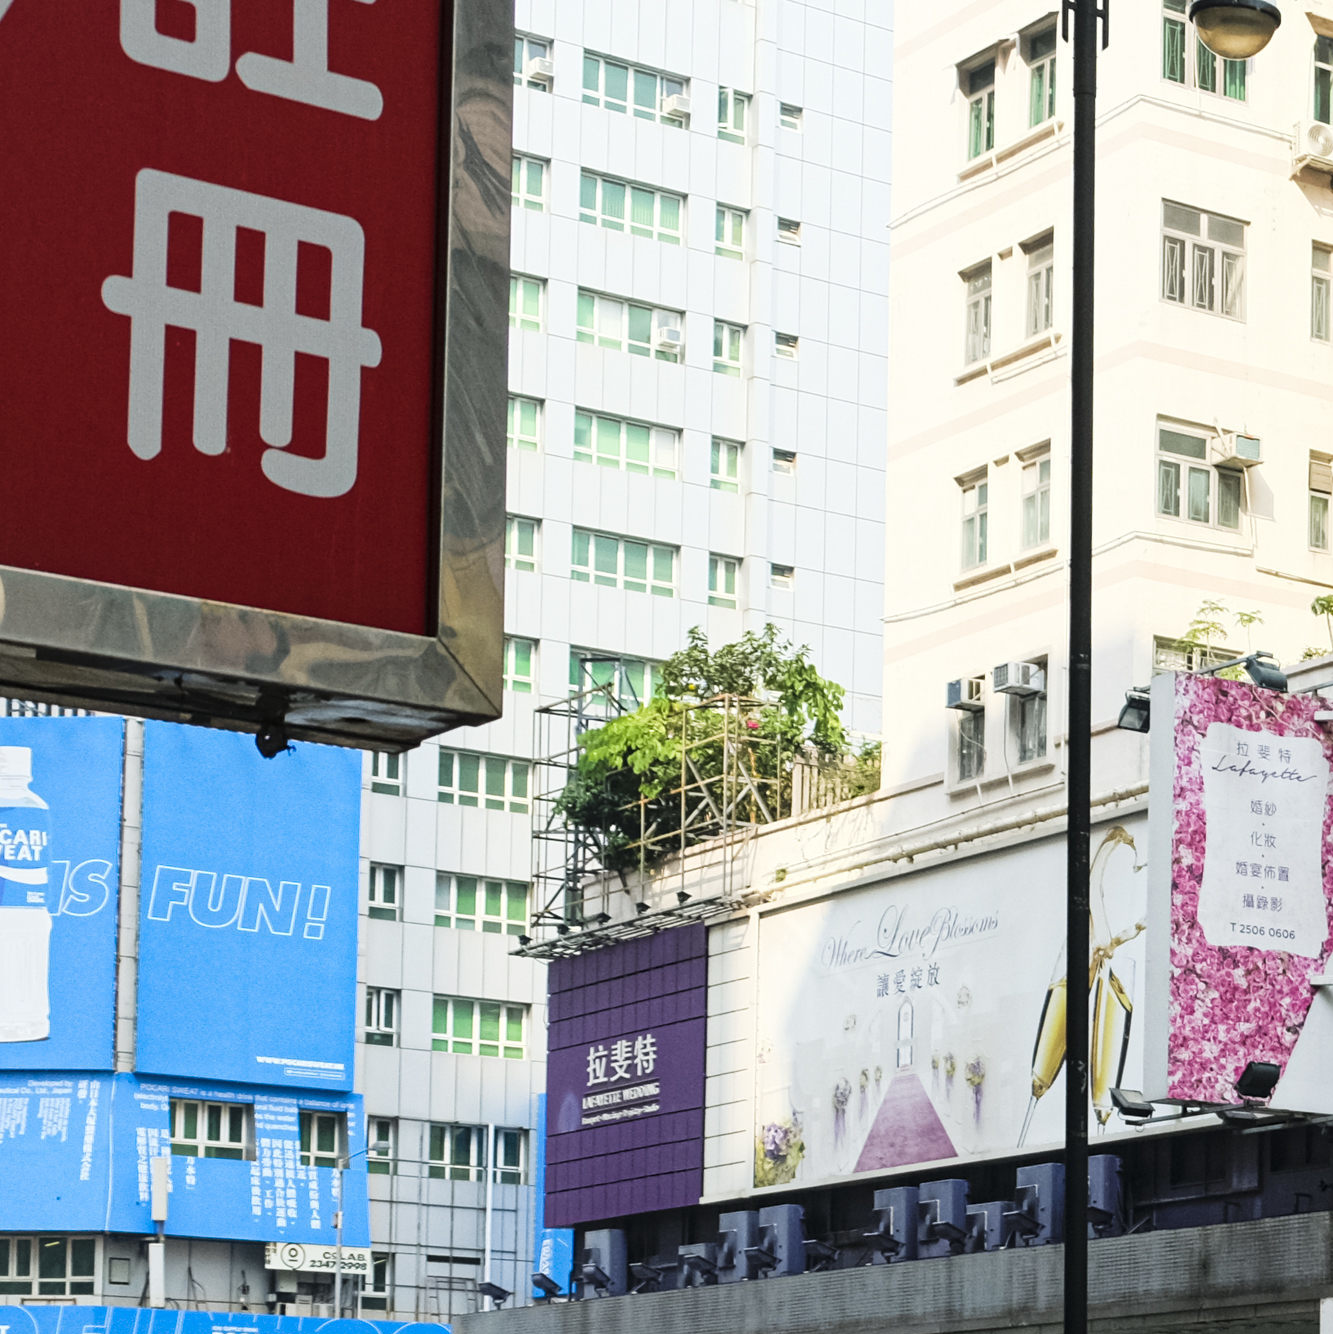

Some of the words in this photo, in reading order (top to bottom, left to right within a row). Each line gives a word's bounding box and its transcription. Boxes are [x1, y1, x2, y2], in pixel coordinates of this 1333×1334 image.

[1211, 755, 1317, 783] Lafayette
[147, 864, 331, 940] FUN!
[1230, 923, 1237, 932] T
[1239, 924, 1265, 936] 2506
[1268, 927, 1296, 940] 0606
[821, 934, 870, 968] Where
[586, 1033, 658, 1087] 拉斐特
